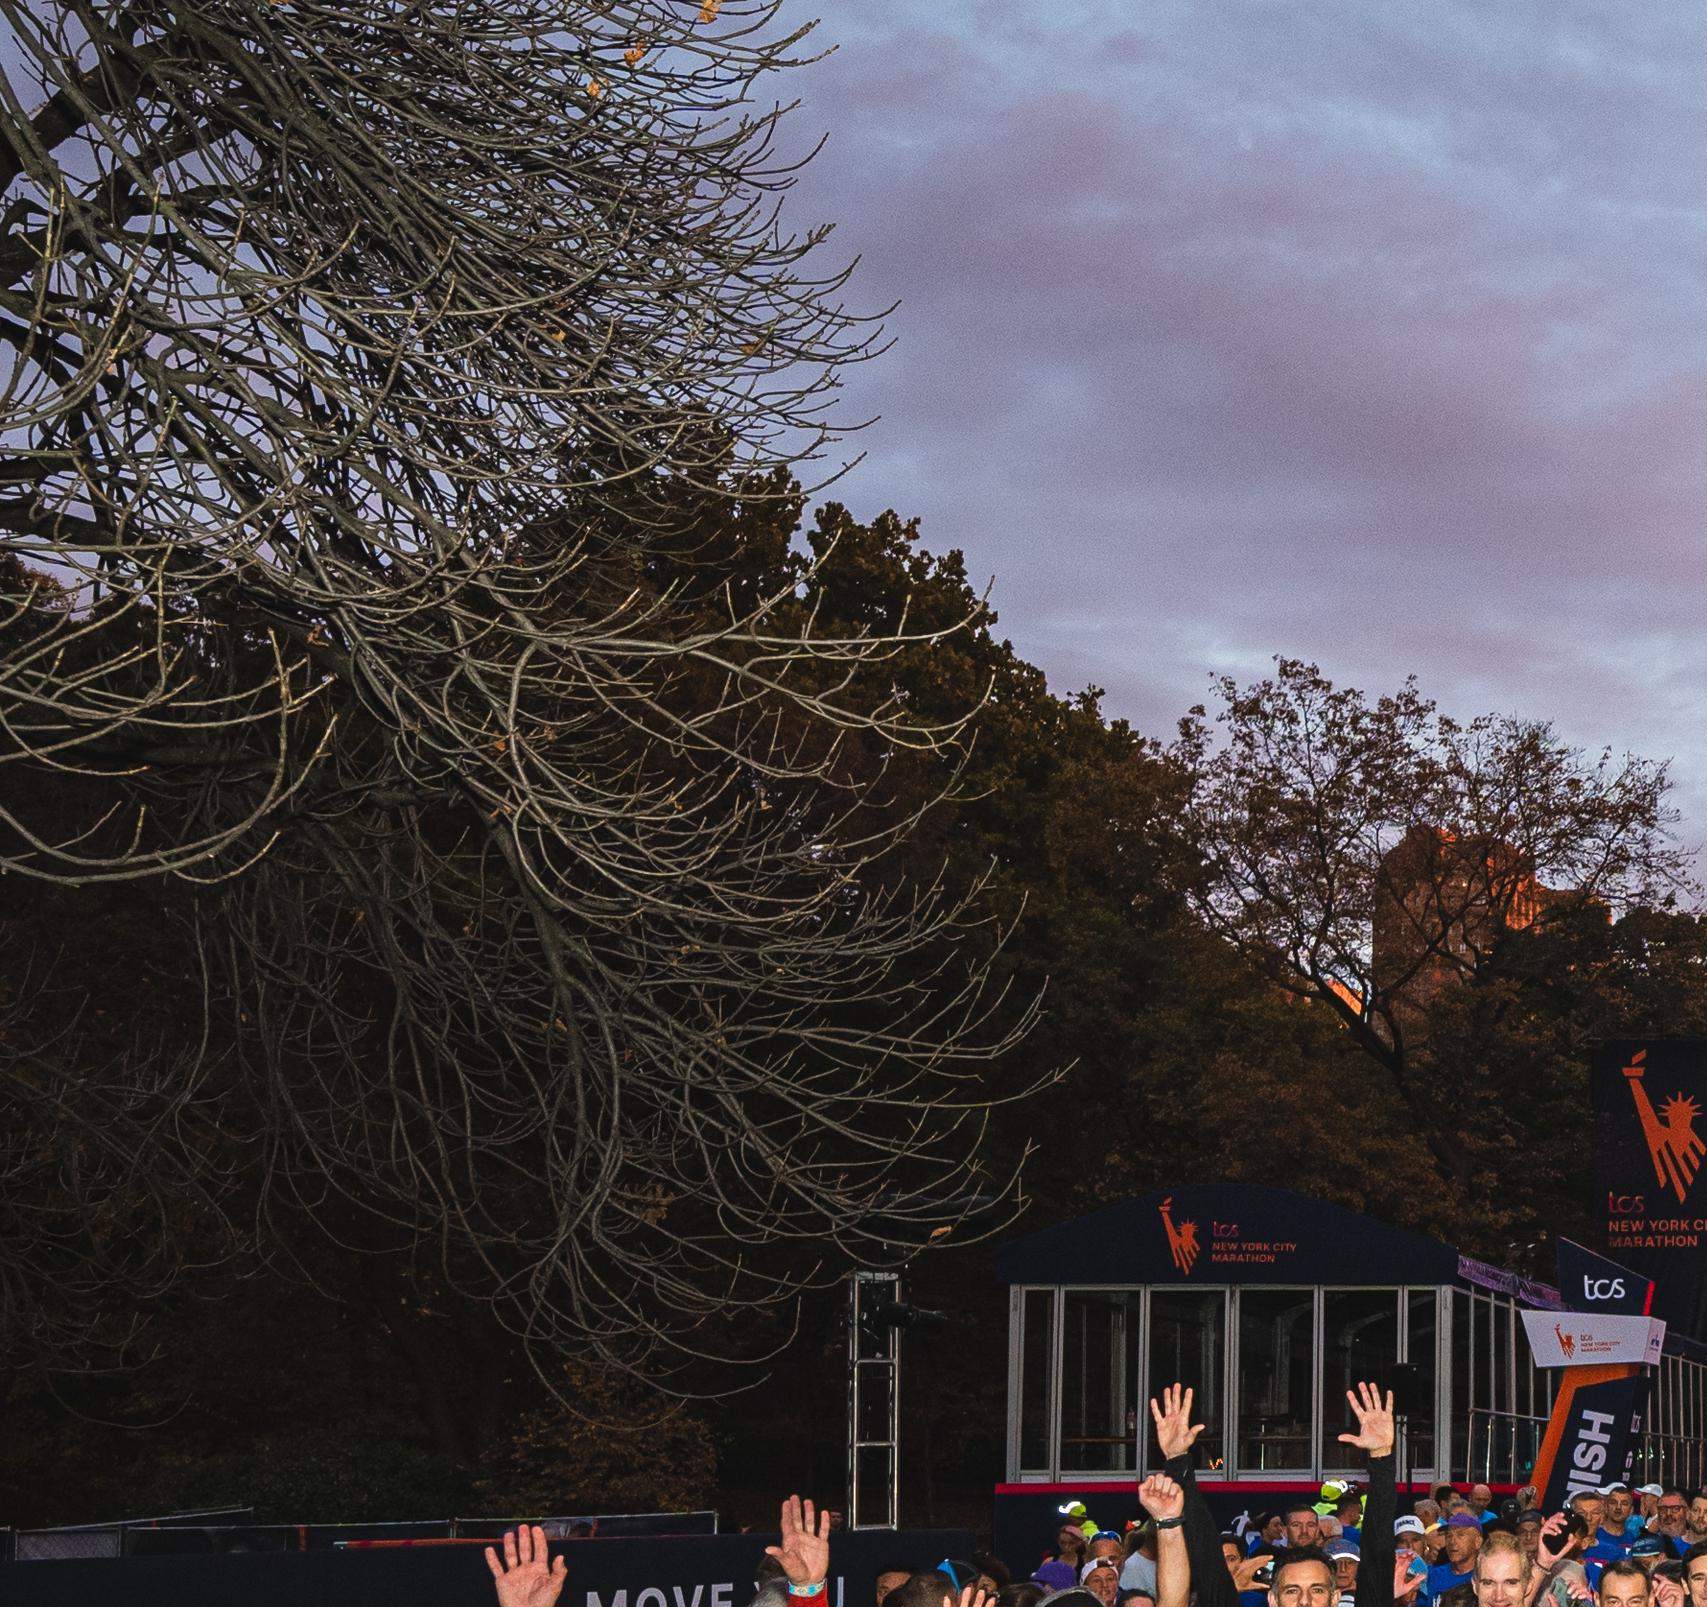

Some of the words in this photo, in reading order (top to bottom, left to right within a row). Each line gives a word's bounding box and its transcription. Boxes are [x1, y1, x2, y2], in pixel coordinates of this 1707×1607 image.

[1608, 1191, 1645, 1213] tcs
[1212, 1220, 1239, 1238] tcs
[1608, 1221, 1645, 1232] NEW
[1650, 1220, 1690, 1232] YORK
[1212, 1242, 1237, 1252] NEW
[1241, 1241, 1270, 1252] YORK
[1273, 1242, 1297, 1252] CITY
[1608, 1235, 1699, 1247] MARATHON
[1211, 1253, 1276, 1263] MARATHON
[1583, 1274, 1626, 1300] tcs
